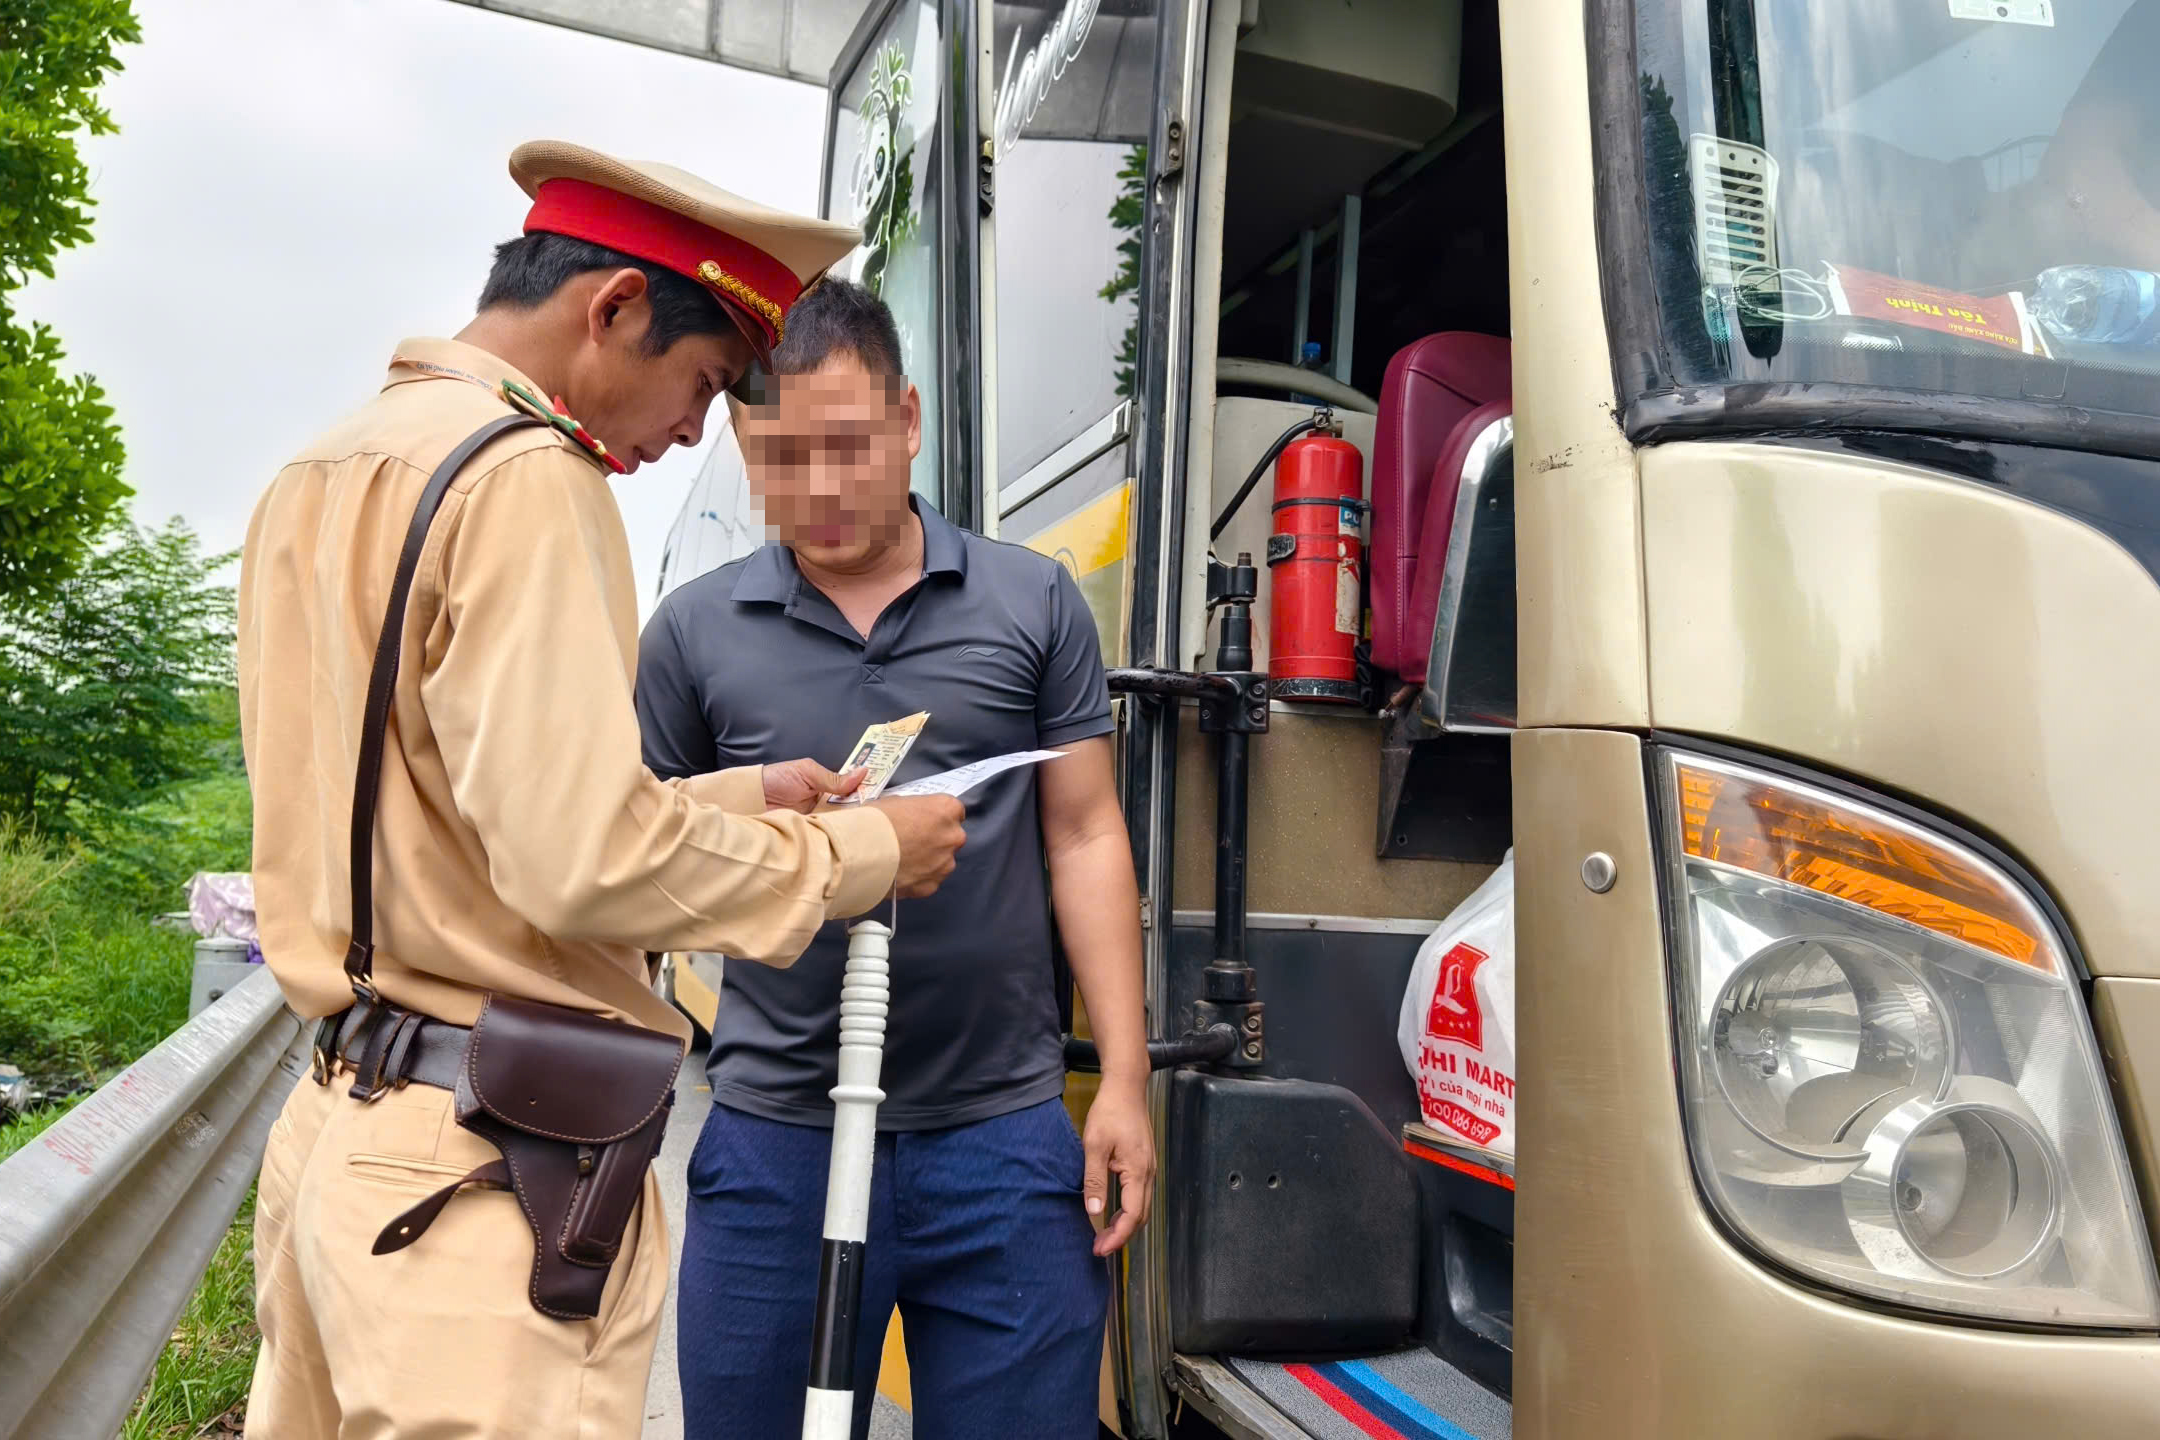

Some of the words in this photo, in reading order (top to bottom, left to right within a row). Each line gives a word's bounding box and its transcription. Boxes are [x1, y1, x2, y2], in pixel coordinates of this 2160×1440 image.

[1884, 297, 1944, 317] Thịnh
[1947, 307, 1986, 326] Tân
[1465, 1056, 1516, 1101] MART
[1439, 1080, 1463, 1097] của
[1466, 1089, 1482, 1108] mọi
[1452, 1109, 1470, 1131] 066
